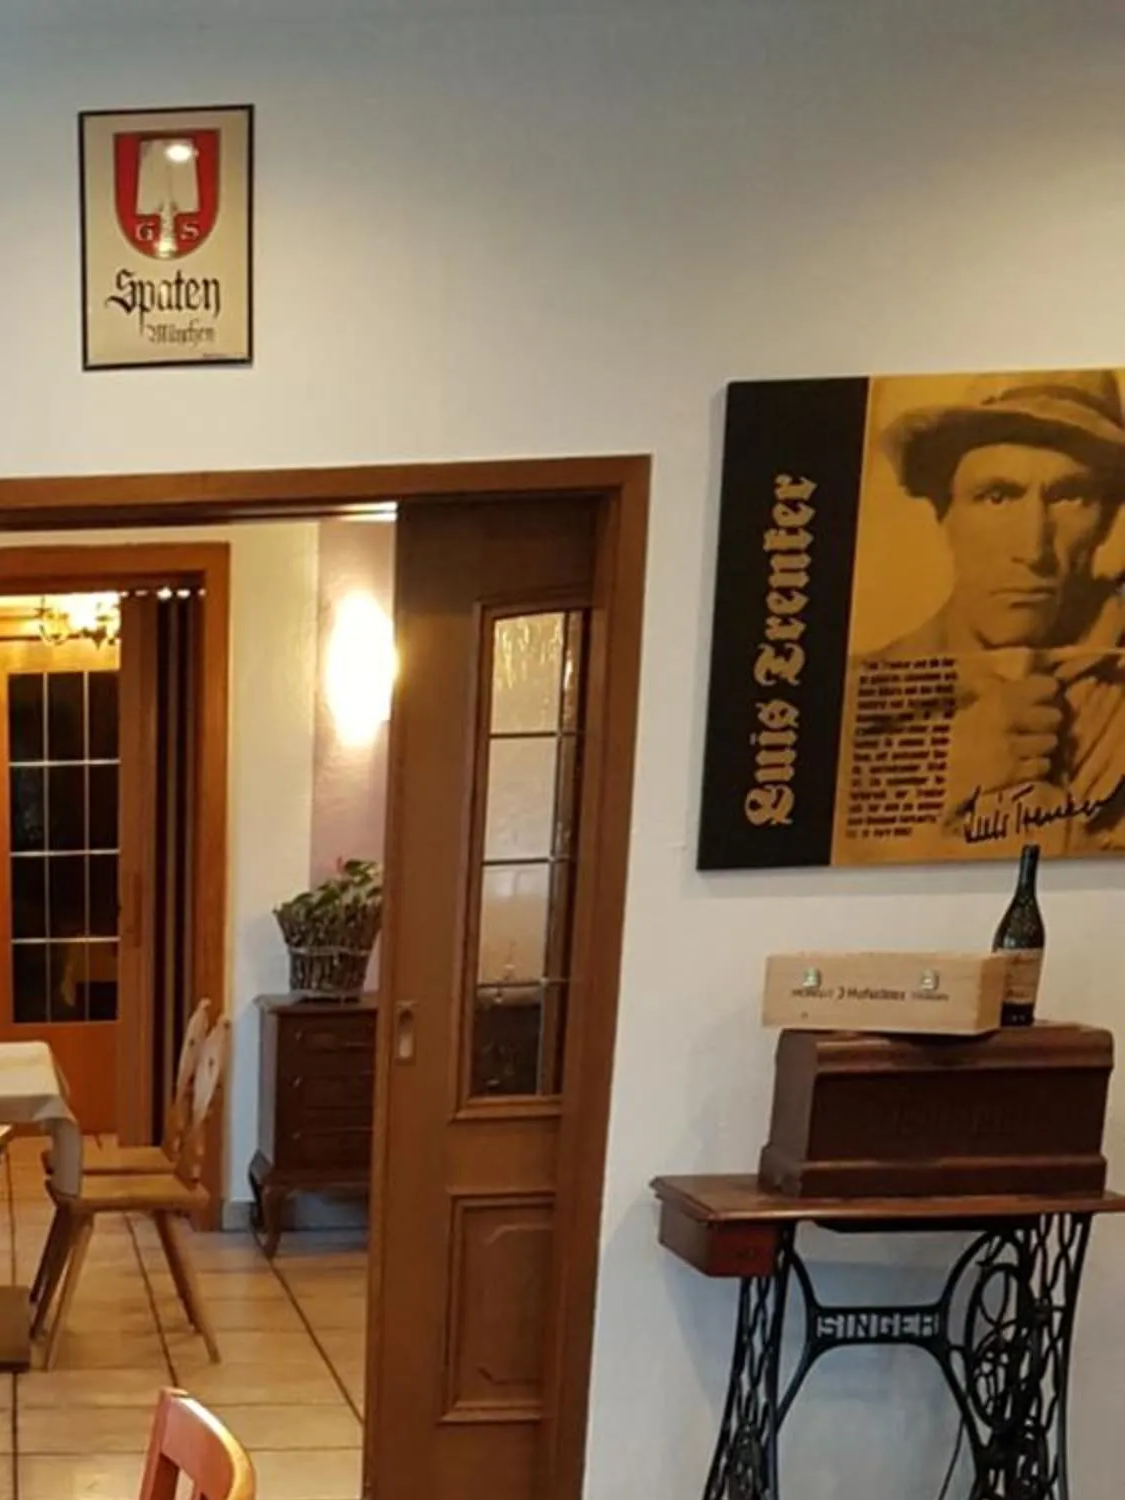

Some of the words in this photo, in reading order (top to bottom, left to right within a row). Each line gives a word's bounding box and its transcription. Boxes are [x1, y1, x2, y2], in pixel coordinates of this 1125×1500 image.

[105, 267, 221, 336] Spaten
[753, 473, 818, 686] Trenker
[744, 699, 800, 826] Luis
[816, 1313, 939, 1338] SINGER
